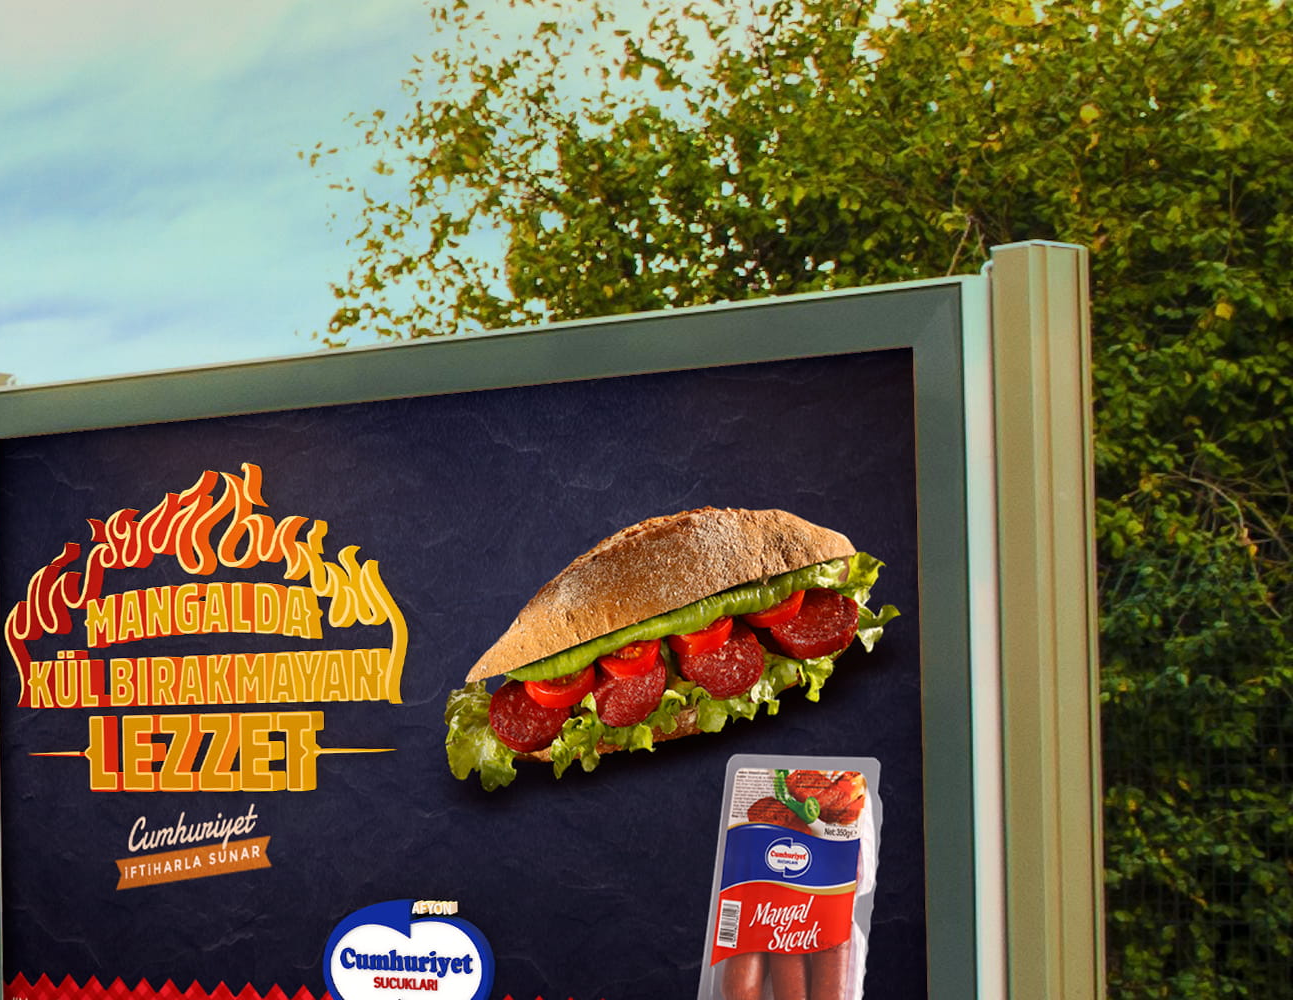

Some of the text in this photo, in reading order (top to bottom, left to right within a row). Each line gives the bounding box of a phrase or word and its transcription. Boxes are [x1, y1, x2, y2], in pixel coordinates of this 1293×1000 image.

[85, 582, 323, 647] MANGALDA
[28, 648, 393, 708] KÜL BIRAKMAYAN
[85, 711, 325, 791] LEZZET
[128, 803, 258, 852] Cumhuriyet
[208, 845, 260, 865] SUNAR
[749, 895, 815, 933] Mangal
[768, 921, 821, 952] Sucuk
[339, 947, 474, 978] Cumhuriyet
[373, 976, 439, 992] SUCUKLARI
